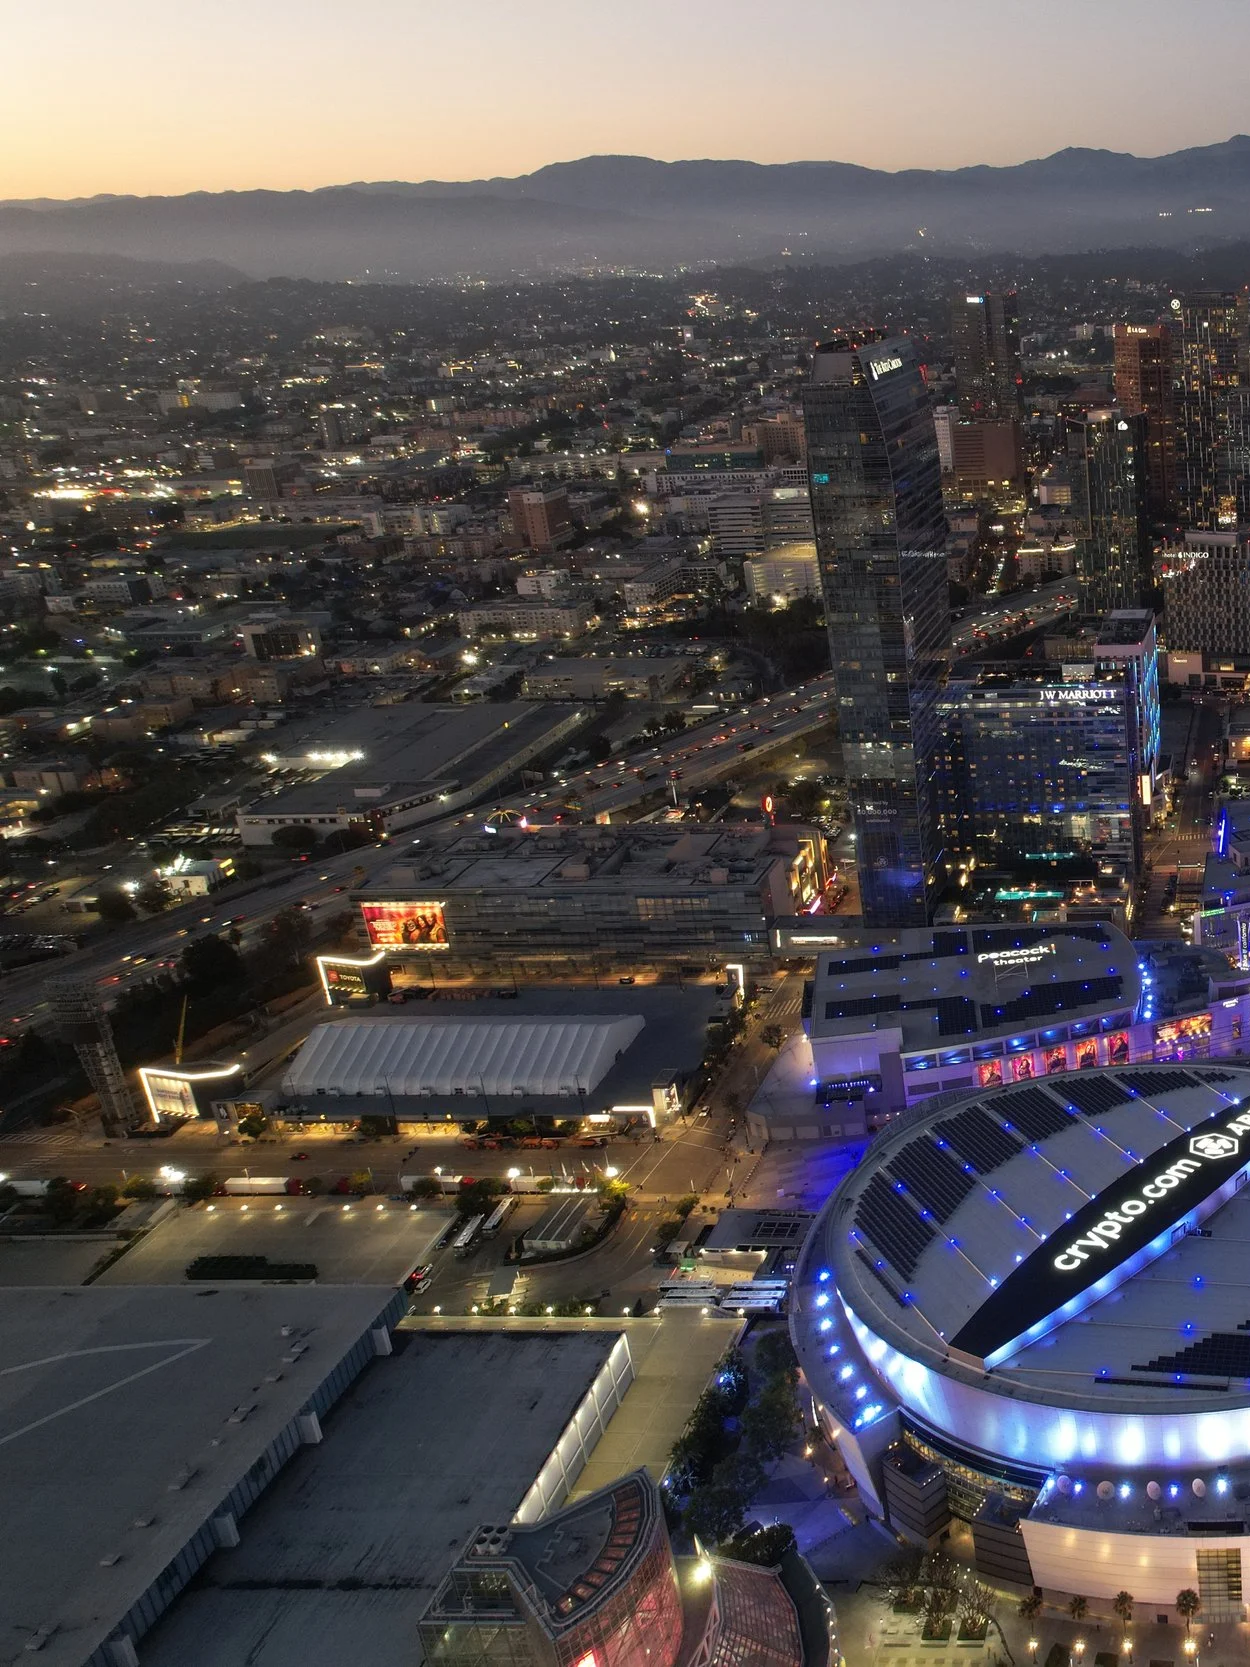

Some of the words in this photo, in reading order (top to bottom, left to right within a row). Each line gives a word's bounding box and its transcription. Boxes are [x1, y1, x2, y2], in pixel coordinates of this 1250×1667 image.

[1183, 551, 1210, 559] INDIGO
[1040, 690, 1056, 701] JW
[1058, 689, 1117, 700] MARRIOTT
[978, 946, 1050, 963] peacock
[993, 955, 1043, 966] theater
[339, 974, 362, 983] TOYOTA
[1053, 1158, 1202, 1271] crypto.com
